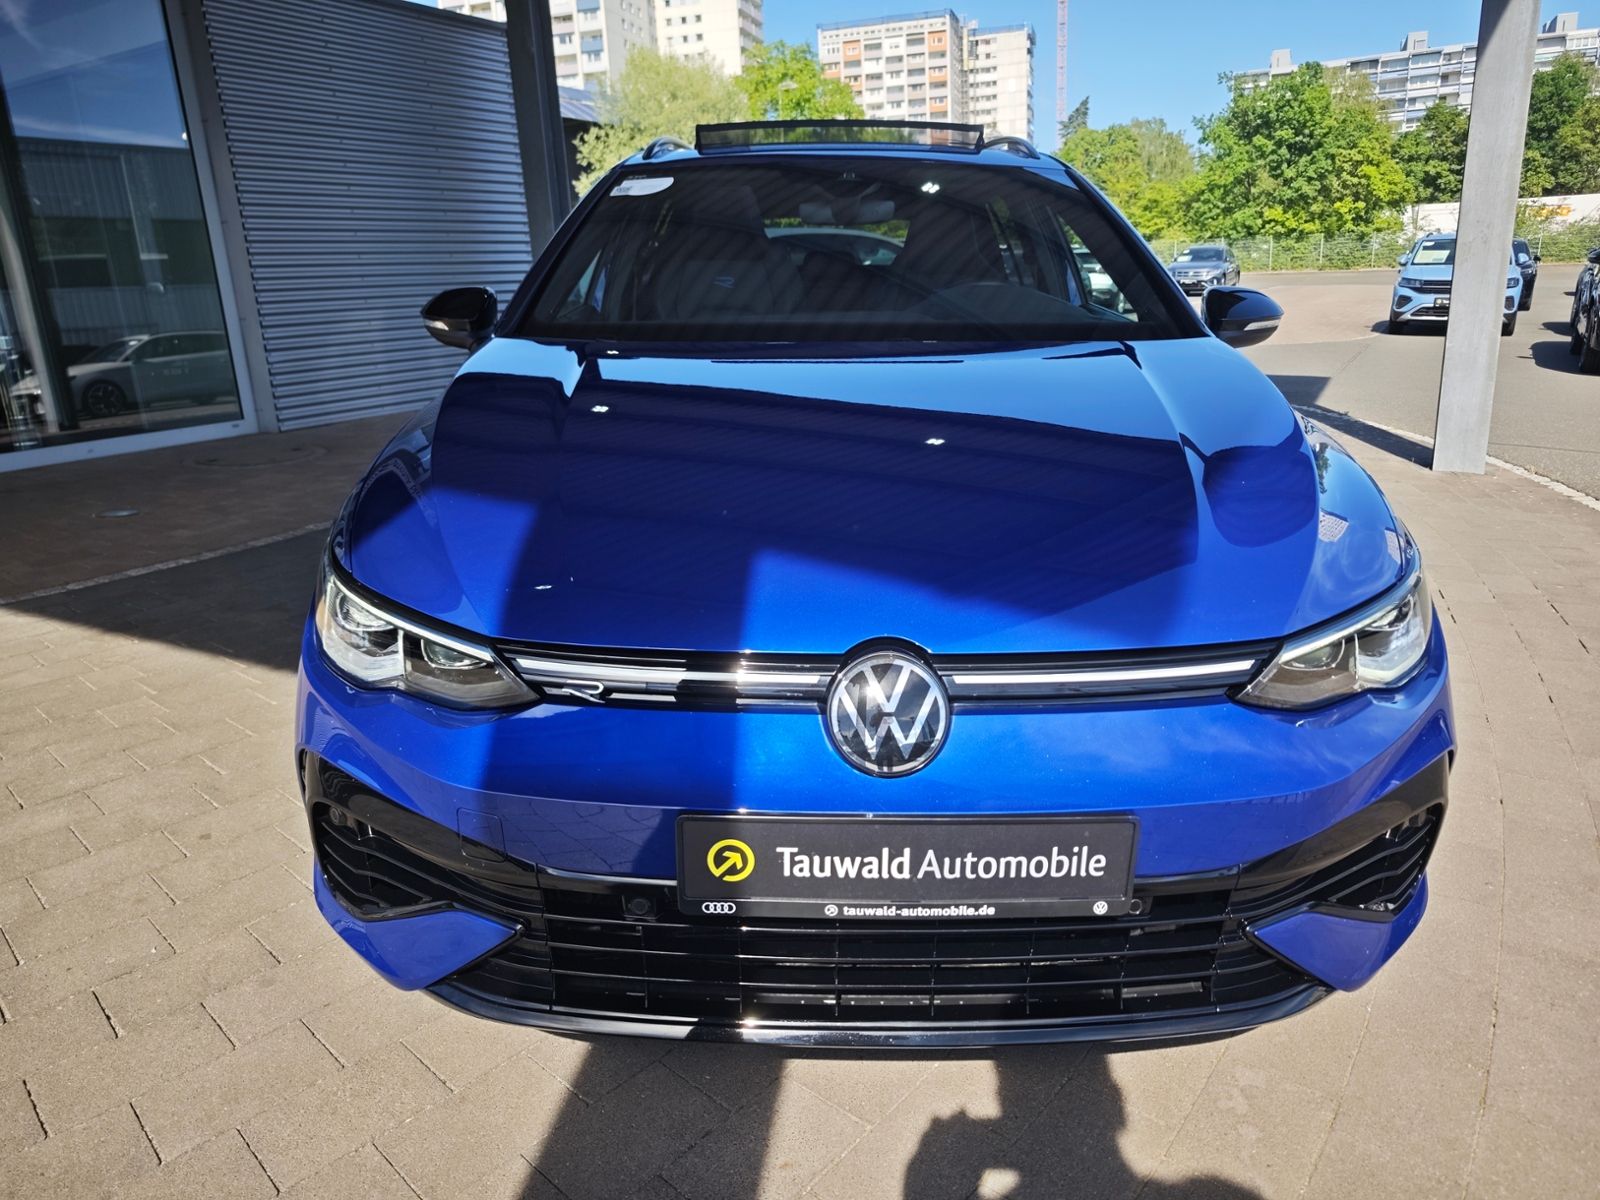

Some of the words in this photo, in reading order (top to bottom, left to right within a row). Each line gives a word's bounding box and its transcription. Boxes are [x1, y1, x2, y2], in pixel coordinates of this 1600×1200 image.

[562, 680, 606, 704] R
[834, 660, 941, 761] VW
[776, 847, 911, 879] Tauwald
[917, 845, 1107, 879] Automobile
[842, 904, 996, 917] tauwald-automobile.de
